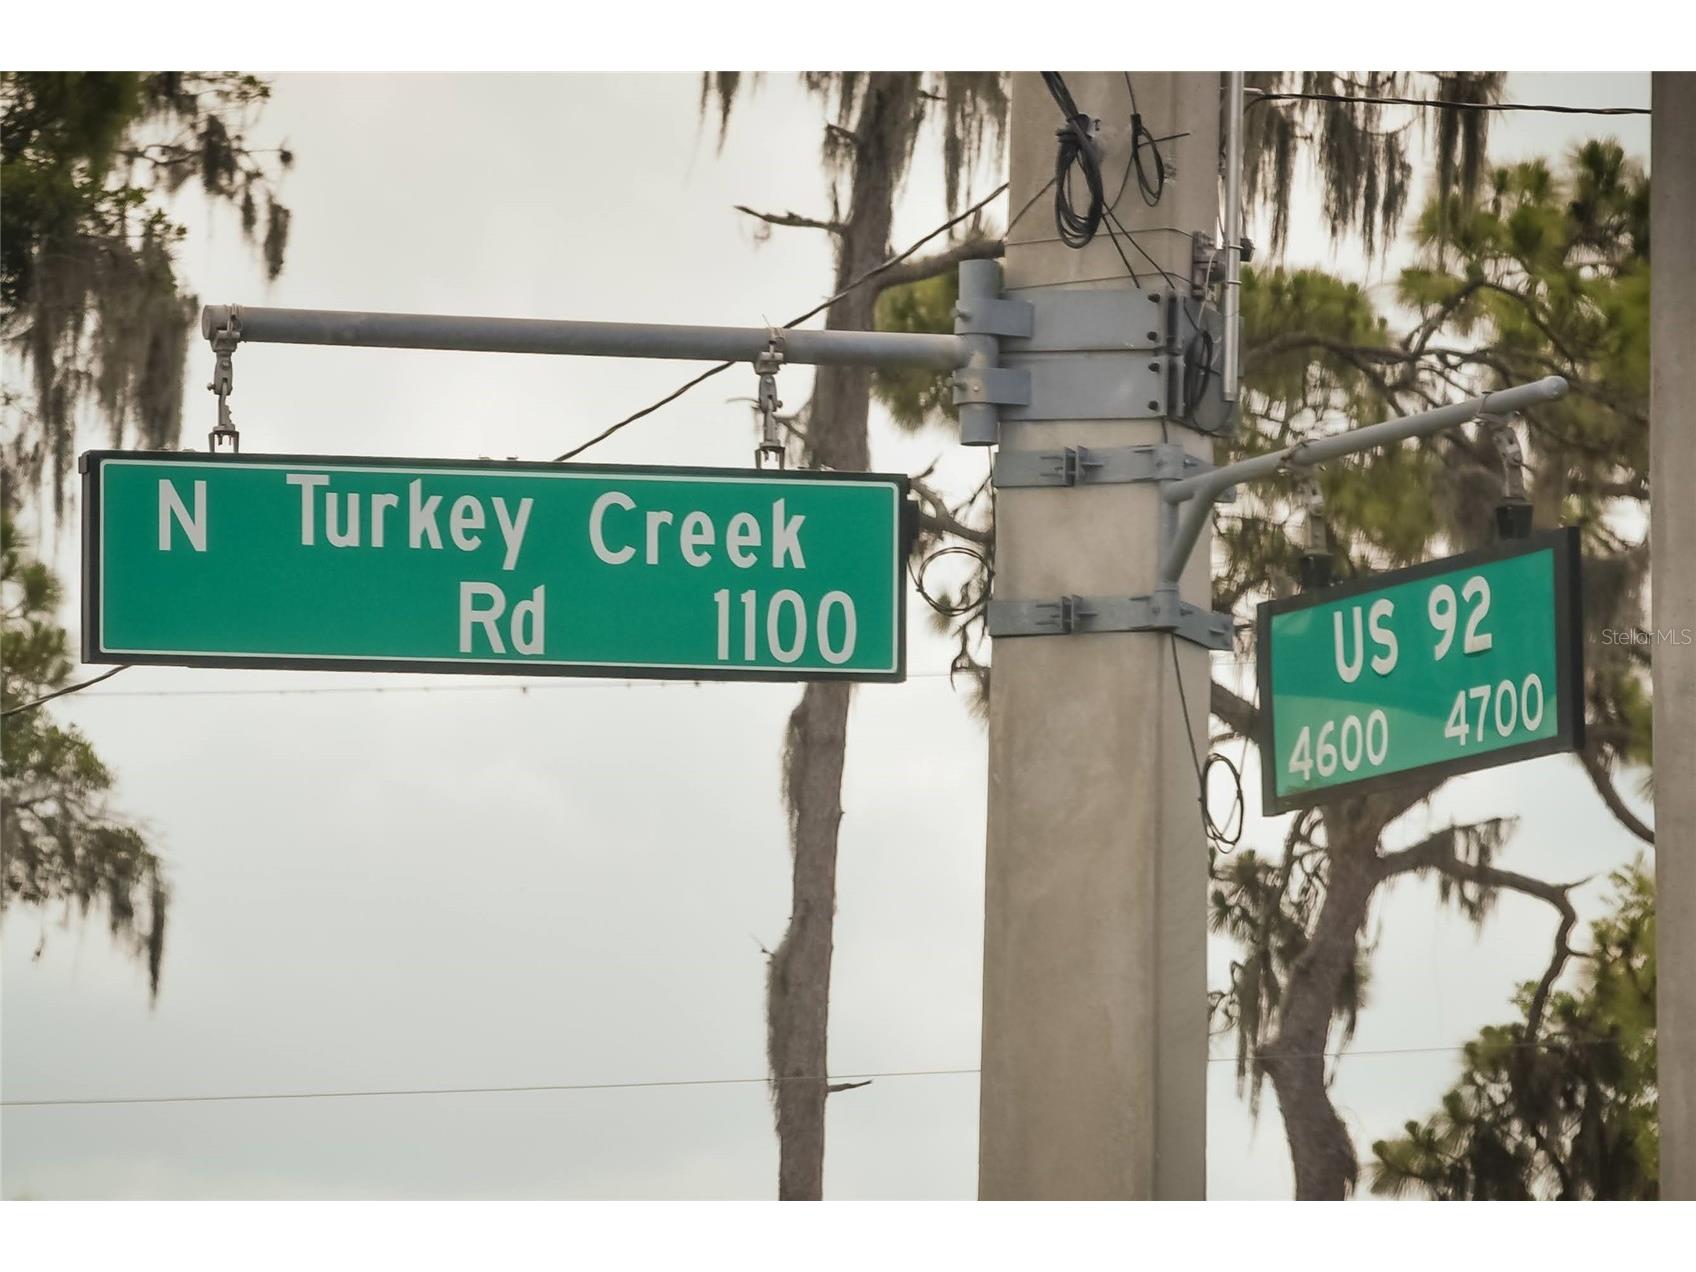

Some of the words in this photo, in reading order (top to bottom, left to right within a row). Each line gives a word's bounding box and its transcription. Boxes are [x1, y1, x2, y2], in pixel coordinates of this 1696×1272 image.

[158, 479, 207, 552] N
[286, 473, 533, 570] Turkey
[589, 491, 806, 569] Creek
[460, 581, 545, 655] Rd
[713, 589, 857, 665] 1100
[1334, 598, 1398, 683] US
[1428, 575, 1492, 661] 92
[1288, 708, 1389, 781] 4600
[1444, 673, 1544, 746] 4700
